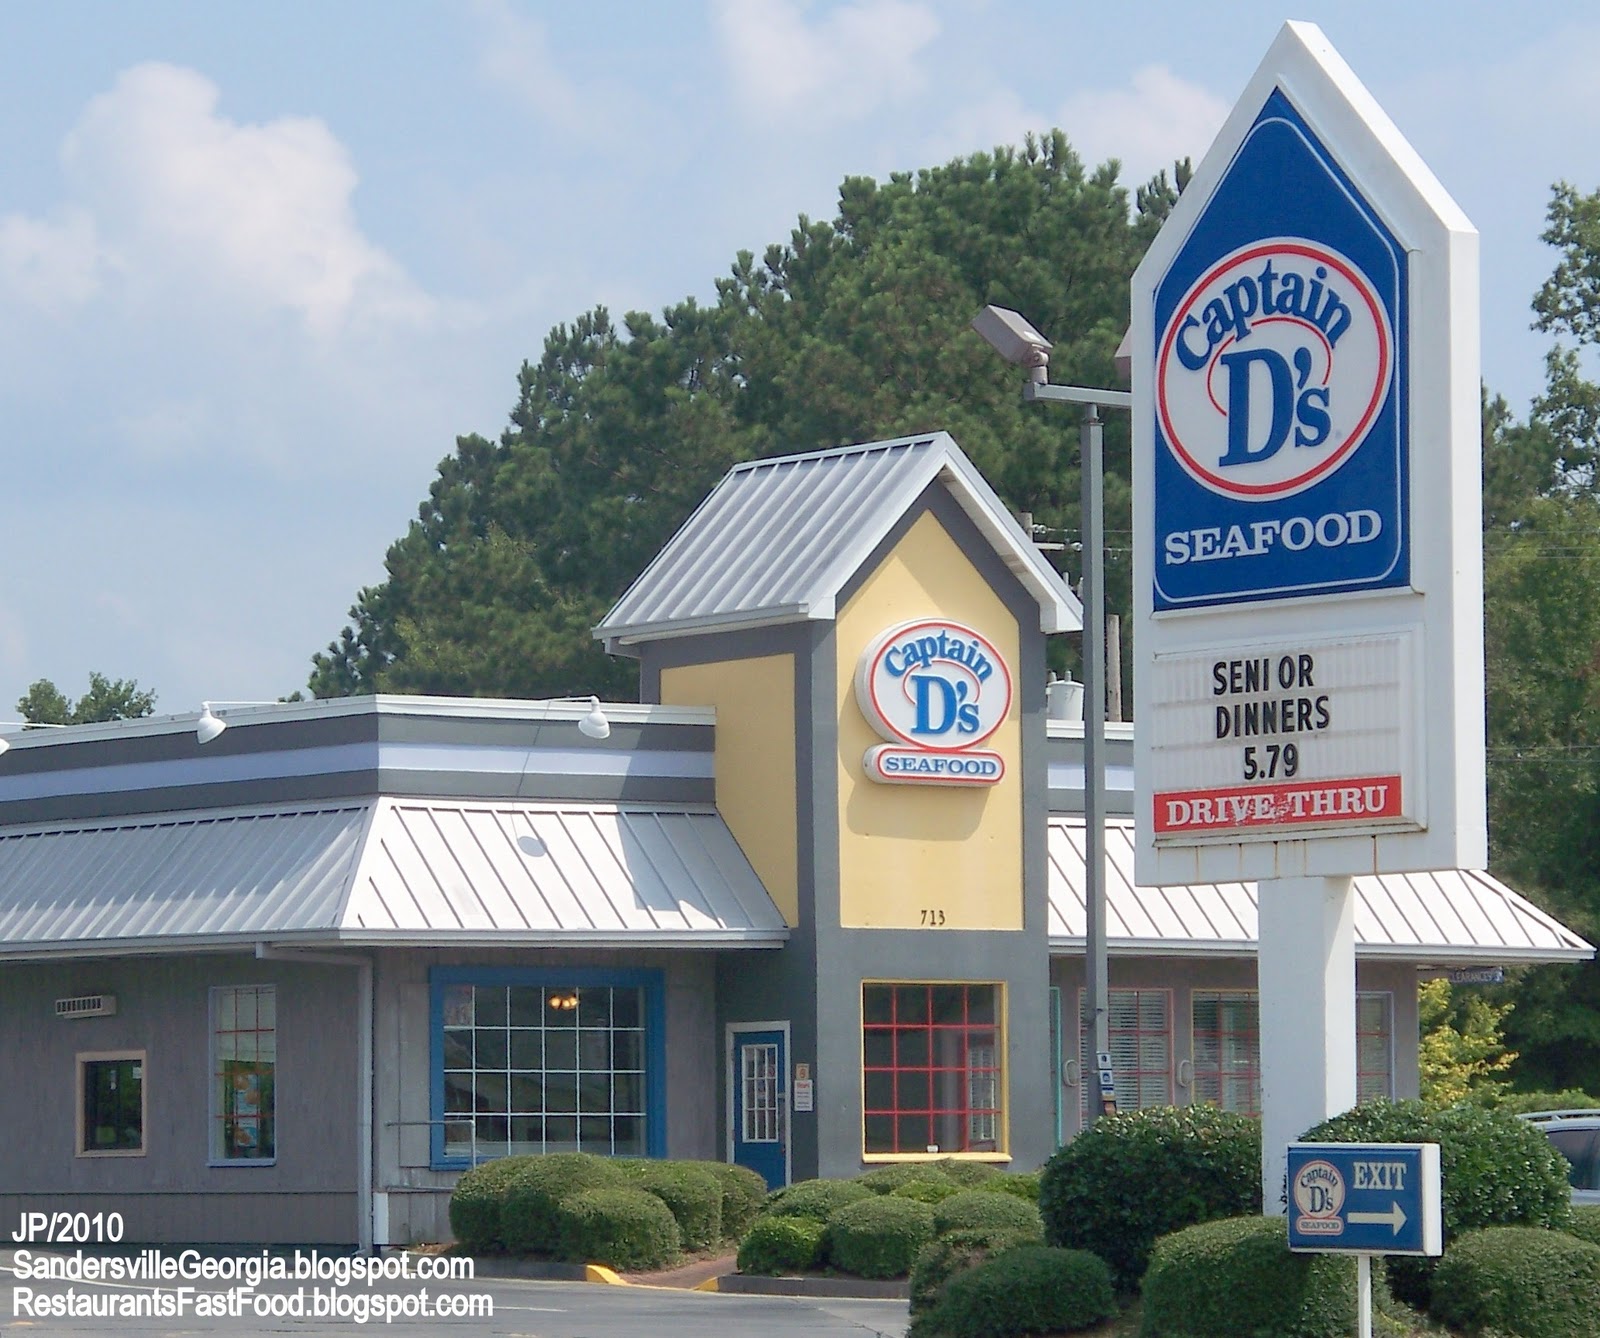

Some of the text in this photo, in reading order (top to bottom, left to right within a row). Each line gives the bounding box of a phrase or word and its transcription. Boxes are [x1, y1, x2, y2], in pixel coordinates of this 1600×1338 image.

[1176, 259, 1352, 371] Captain
[1218, 347, 1332, 467] D's
[1165, 509, 1382, 565] SEAFOOD
[885, 629, 993, 685] Captain
[910, 674, 980, 735] D's
[1216, 695, 1330, 739] DINNERS
[886, 756, 997, 776] SEAFOOD
[1243, 743, 1299, 780] 5.79
[1285, 785, 1388, 818] THRU
[920, 909, 946, 927] 713
[1300, 1167, 1339, 1188] Captain
[1353, 1162, 1407, 1190] EXIT
[1309, 1185, 1334, 1213] D's
[1301, 1222, 1340, 1230] SEAFOOD
